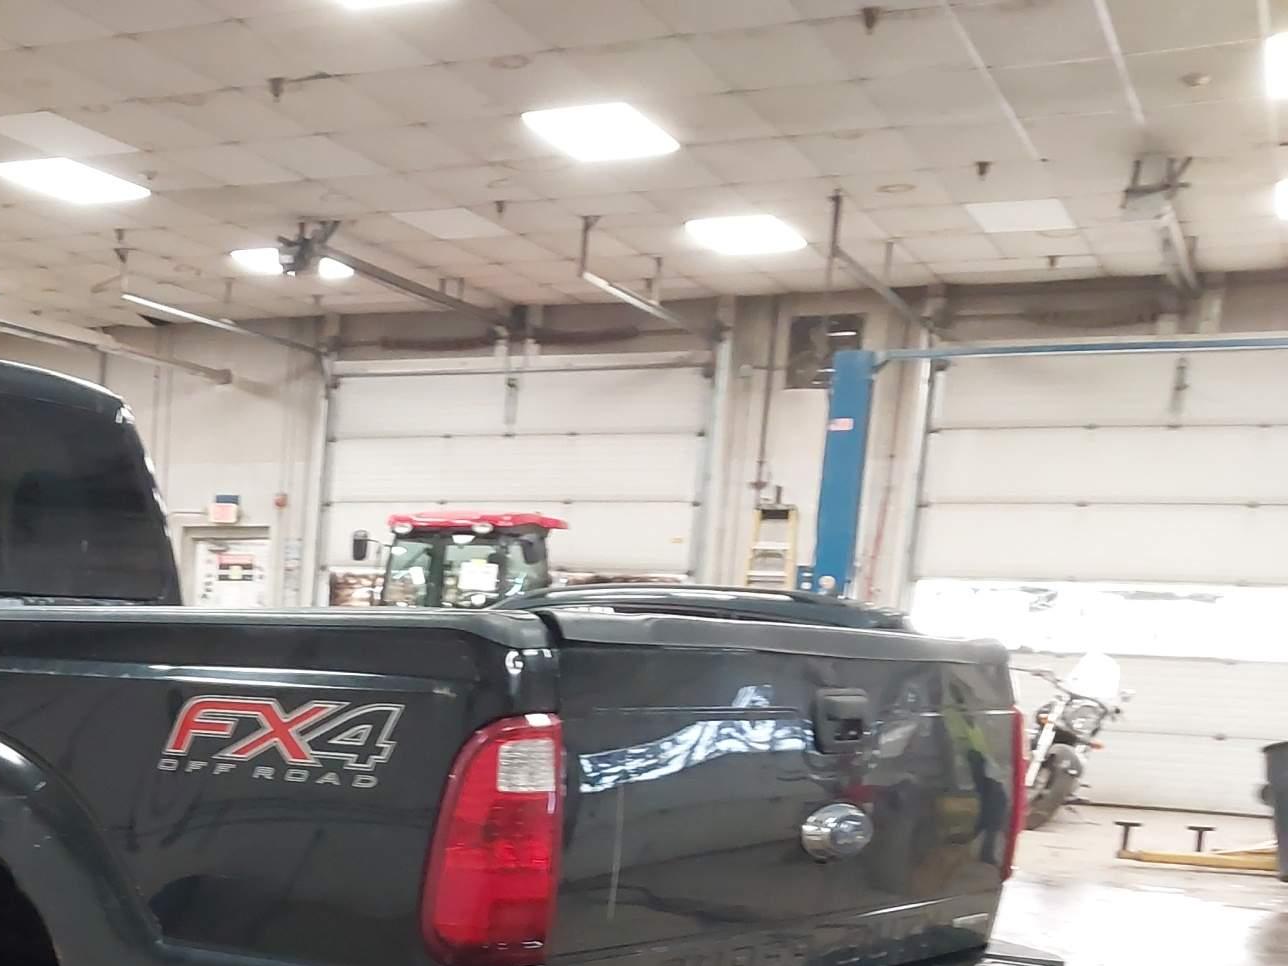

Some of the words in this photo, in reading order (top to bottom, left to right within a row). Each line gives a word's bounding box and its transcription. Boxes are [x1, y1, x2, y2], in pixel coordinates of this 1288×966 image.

[162, 695, 405, 771] FX4
[157, 758, 236, 775] OFF
[252, 766, 378, 788] ROAD
